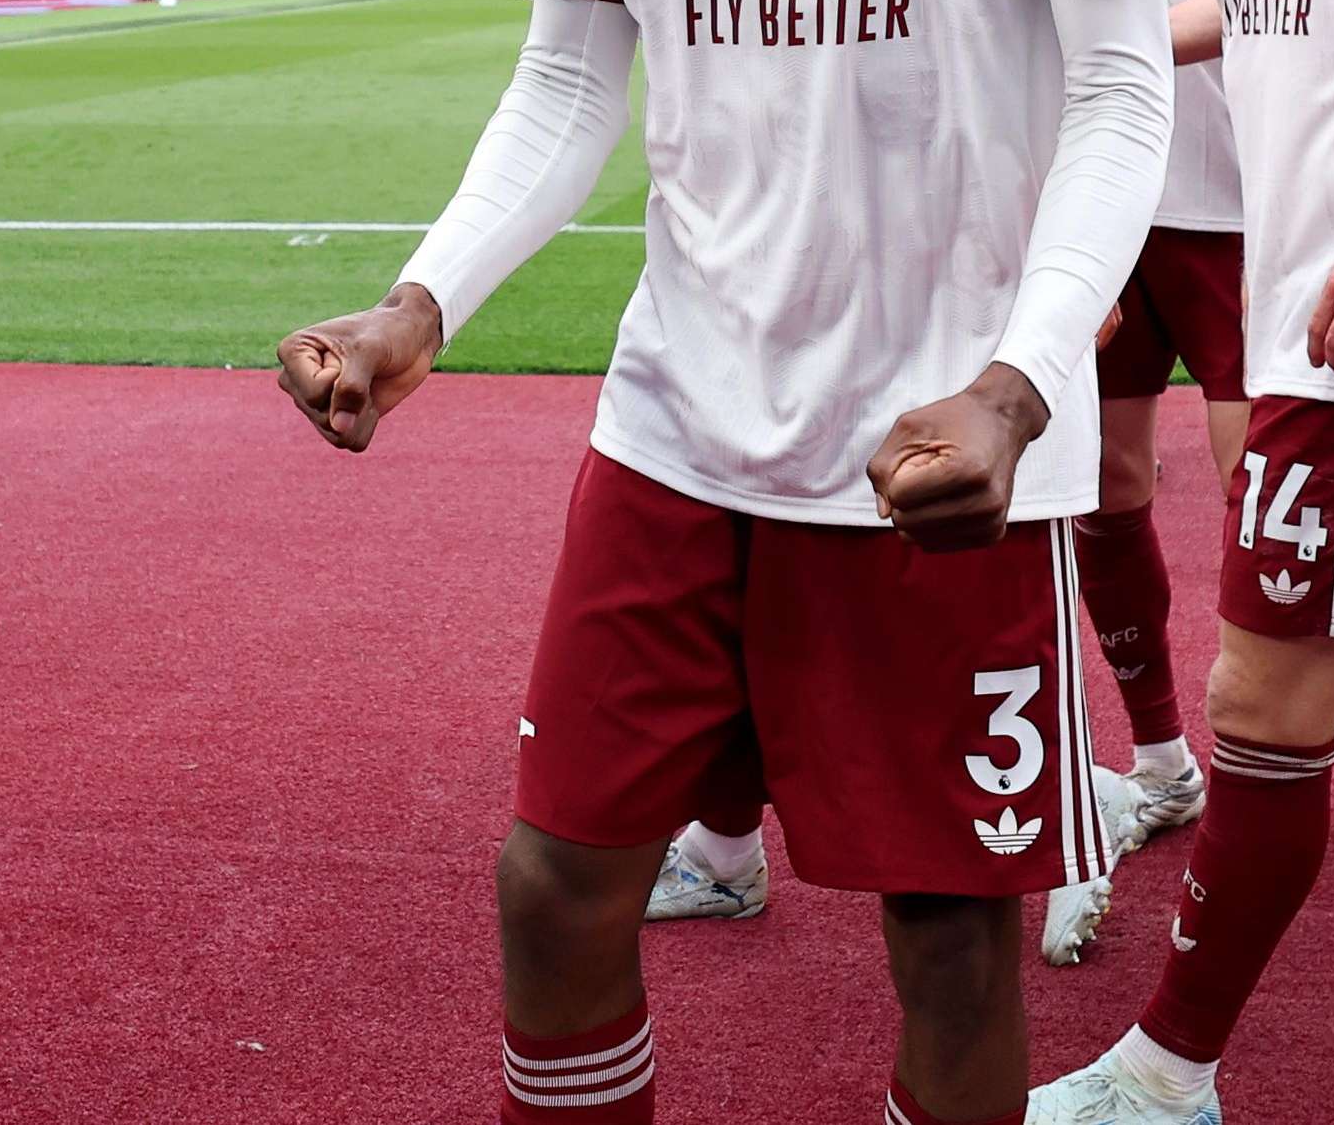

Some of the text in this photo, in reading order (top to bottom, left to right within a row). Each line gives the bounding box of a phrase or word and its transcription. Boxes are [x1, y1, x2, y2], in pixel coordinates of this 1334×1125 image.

[1238, 451, 1328, 562] 14
[1100, 626, 1139, 648] AFC
[965, 665, 1044, 796] 3
